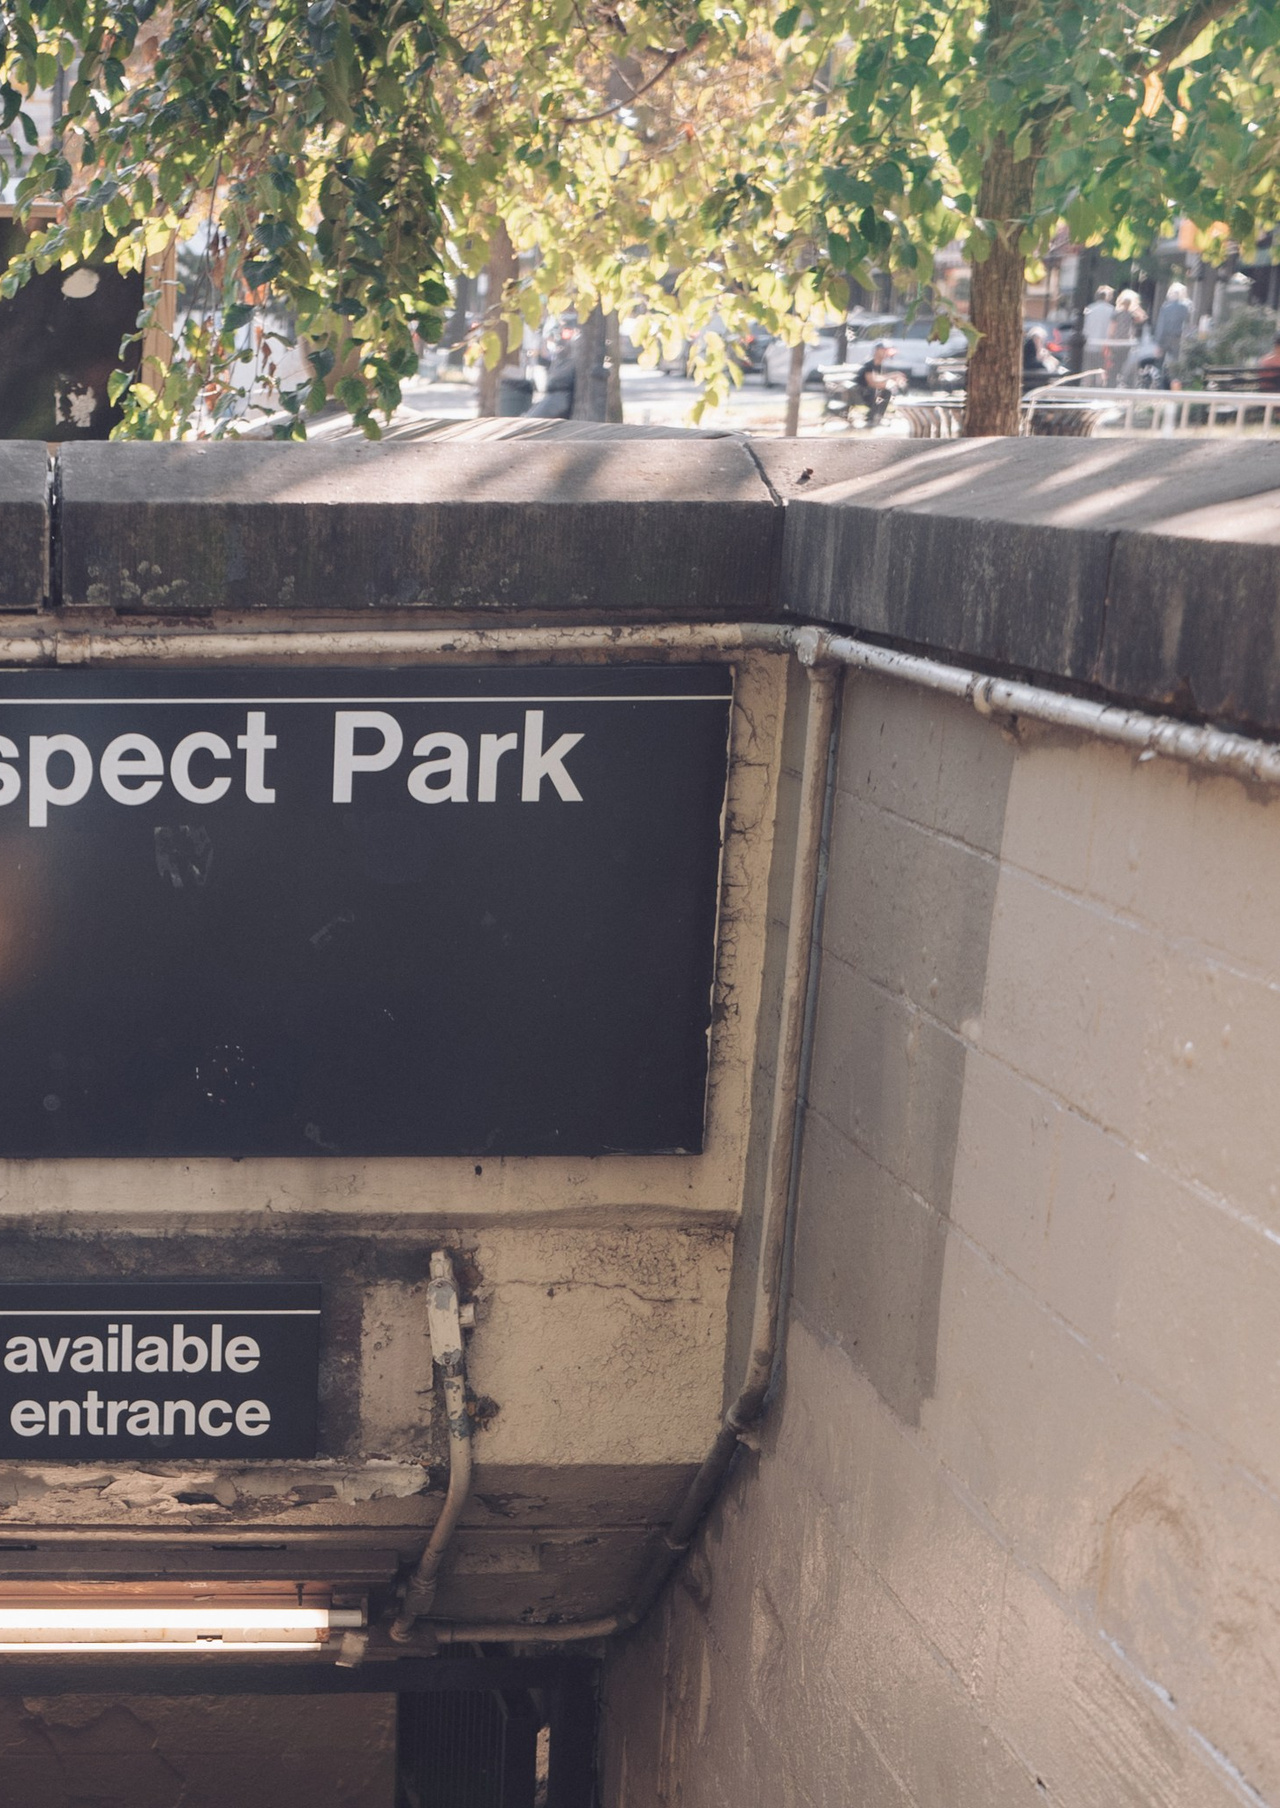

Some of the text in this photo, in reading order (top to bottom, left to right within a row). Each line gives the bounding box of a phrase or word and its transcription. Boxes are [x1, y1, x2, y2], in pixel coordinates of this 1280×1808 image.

[332, 710, 585, 804] Park
[4, 1324, 261, 1373] available
[10, 1390, 271, 1437] entrance
